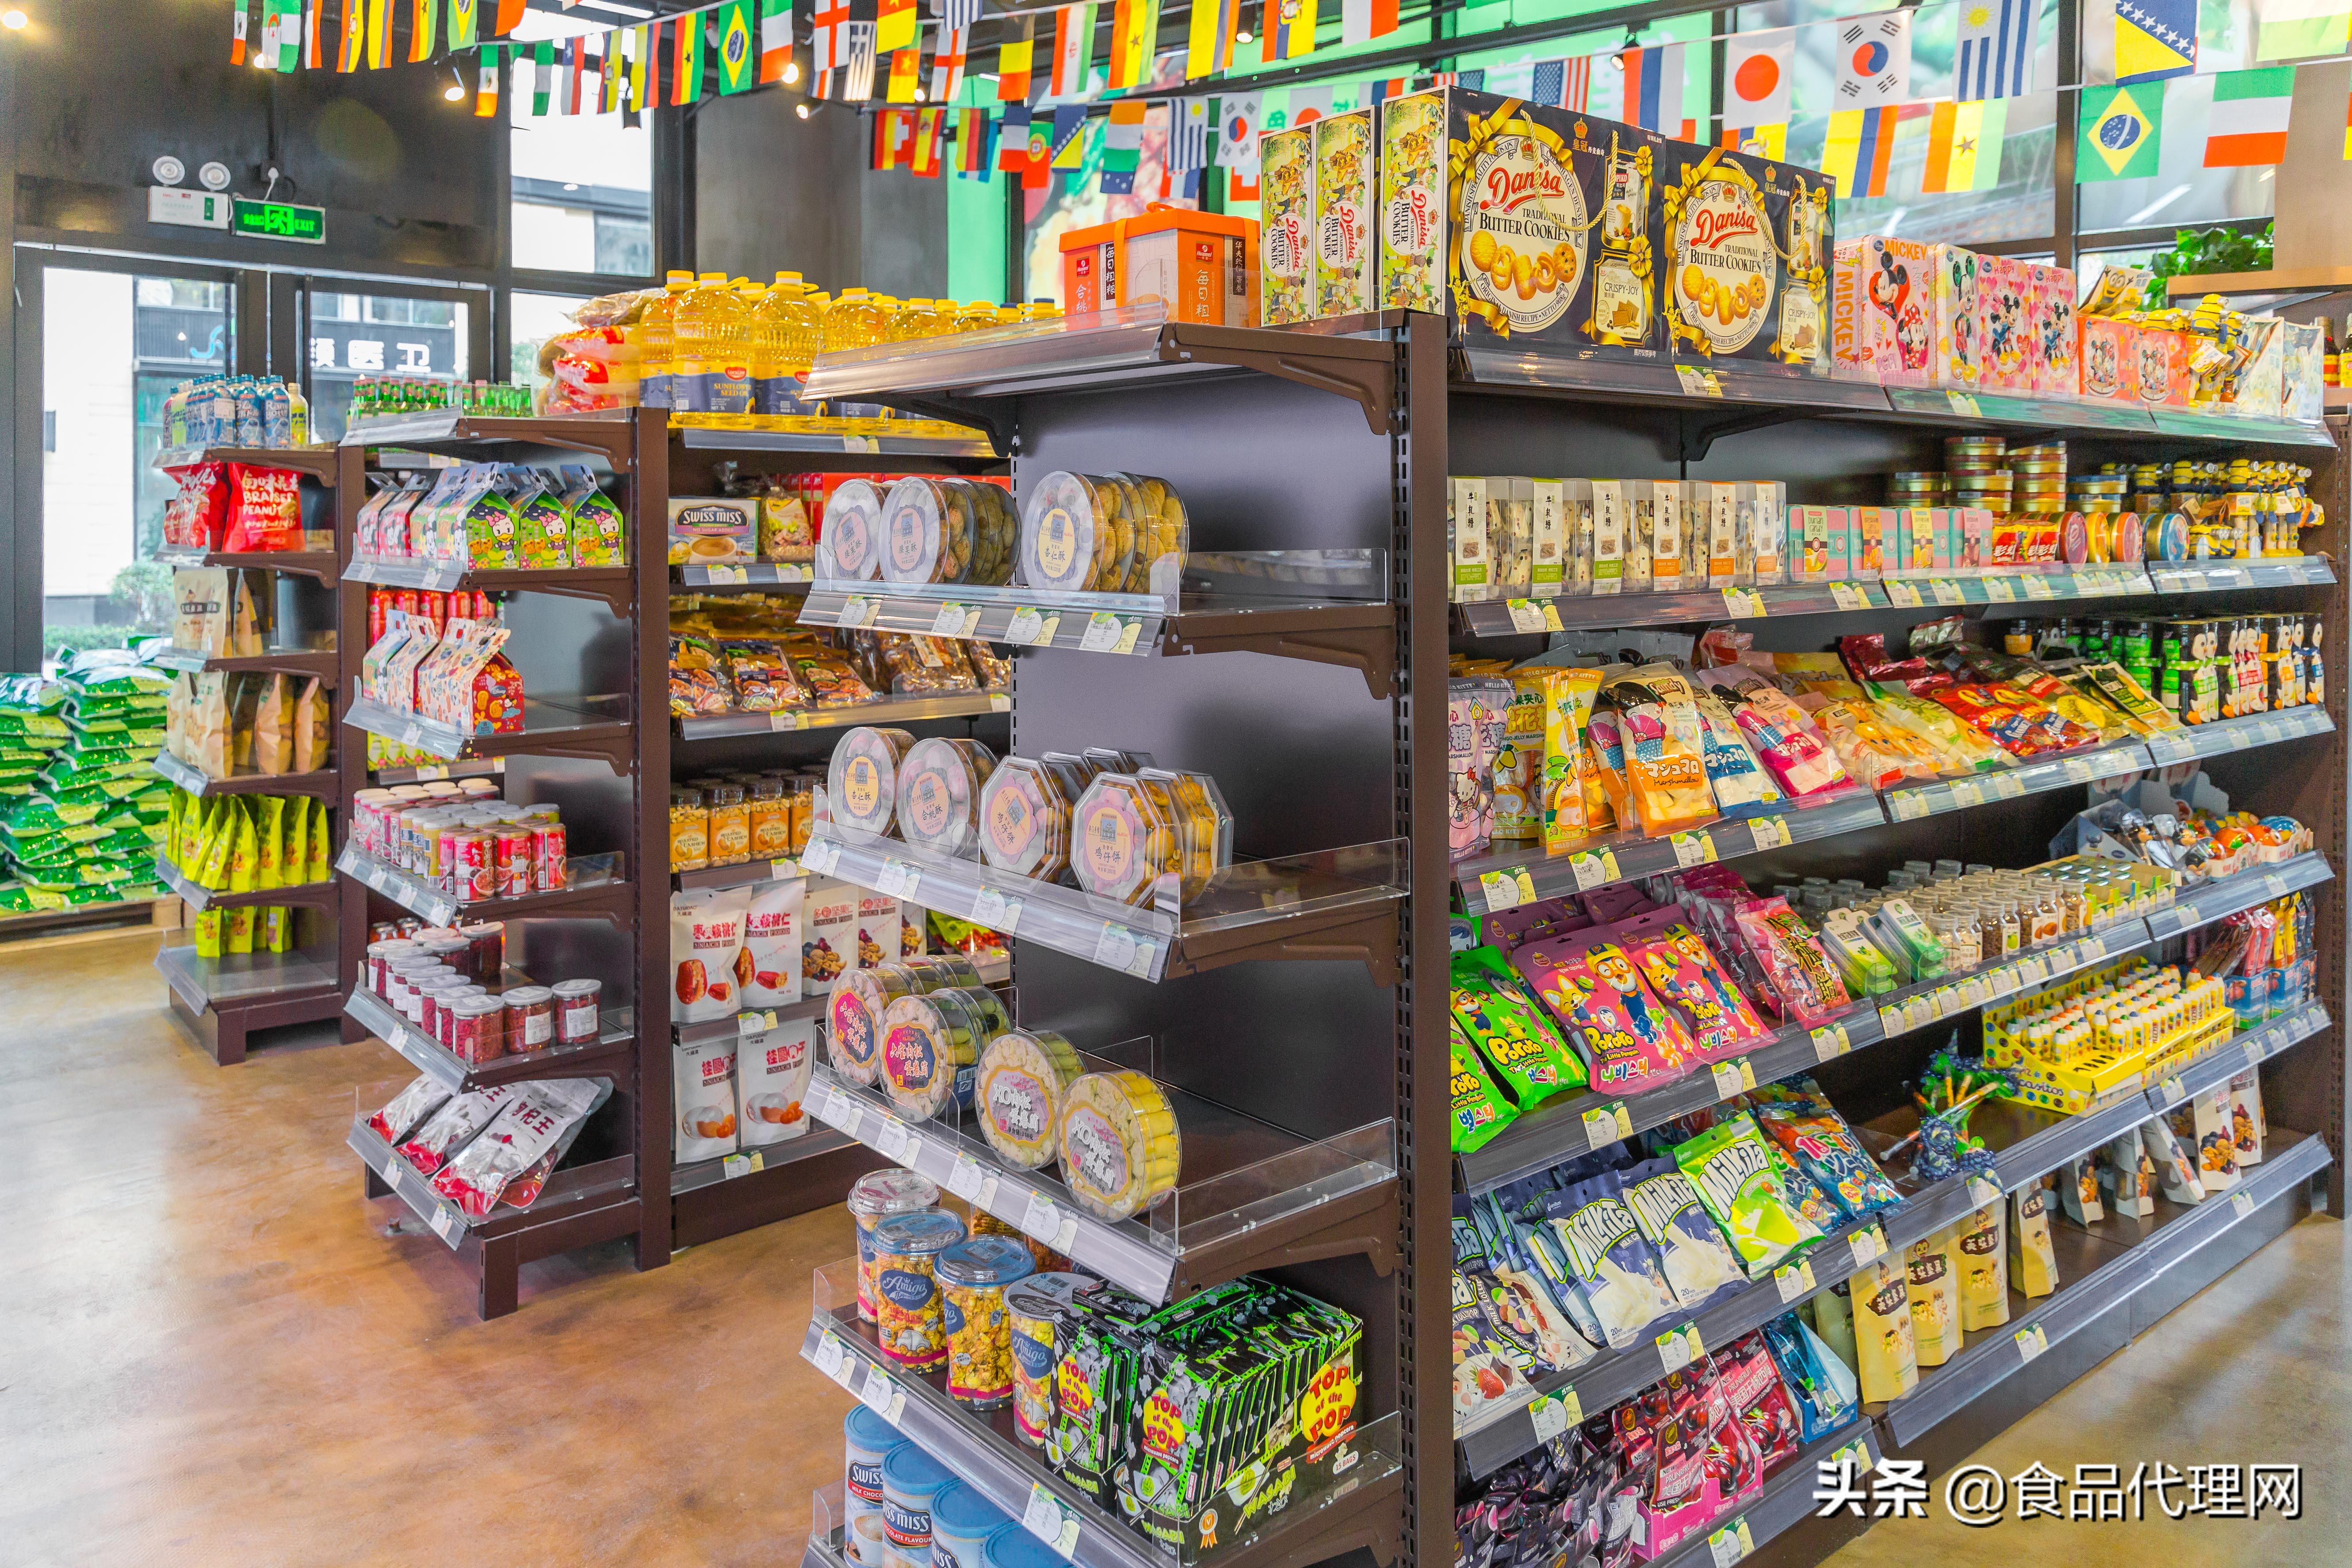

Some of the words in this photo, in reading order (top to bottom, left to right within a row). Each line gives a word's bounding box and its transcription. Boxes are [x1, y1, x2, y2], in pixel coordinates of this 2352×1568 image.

[1572, 140, 1587, 152] 皇冠
[1480, 162, 1565, 215] Danisa
[294, 218, 314, 231] EXIT
[1401, 202, 1410, 243] BUTTER
[1411, 190, 1426, 250] Danisa
[1480, 212, 1522, 236] BUTTER
[1524, 220, 1569, 242] COOKIES
[1690, 204, 1758, 250] Danisa
[1340, 205, 1355, 262] Danisa
[1286, 217, 1300, 271] Danisa
[1725, 245, 1759, 257] TRADITIONAL
[1884, 239, 1927, 260] MICKEY
[1690, 249, 1724, 266] BUTTER
[1726, 256, 1761, 274] COOKIES
[1994, 265, 2014, 275] Happy
[1196, 269, 1210, 324] 每日粗
[1604, 282, 1639, 296] CRISPY-JOY
[1541, 304, 1557, 318] NETTO
[1788, 308, 1816, 319] CRISPY-JOY
[1835, 271, 1853, 360] MICKEY
[683, 510, 714, 524] SWISS
[717, 511, 742, 524] MISS
[1044, 548, 1065, 561] 杏仁酥
[1705, 748, 1748, 767] マシュマロ
[1645, 758, 1699, 778] マシュマロ
[1654, 776, 1699, 787] Marshmallow
[852, 791, 871, 802] 杏仁酥
[921, 804, 943, 821] 合桃酥
[1095, 849, 1121, 864] 鸡仔饼
[1454, 850, 1465, 859] HELLO
[1584, 1026, 1635, 1056] Pororo
[1698, 1026, 1737, 1051] 나비스틱
[1487, 1036, 1543, 1066] Pororo
[904, 1060, 928, 1078] 蛋卷筒
[1601, 1056, 1649, 1083] 나비스틱
[1467, 1093, 1485, 1104] Penguin
[1010, 1107, 1039, 1132] 蛋卷筒
[1457, 1102, 1495, 1133] 별스틱
[883, 1276, 928, 1296] Amigo
[1610, 1327, 1618, 1336] 20
[1013, 1336, 1048, 1365] Amigo
[1063, 1359, 1088, 1384] TOP
[1074, 1382, 1083, 1395] the
[1308, 1365, 1349, 1399] TOP
[1062, 1387, 1088, 1411] POP
[1151, 1394, 1182, 1418] TOP
[1316, 1400, 1325, 1414] of
[1328, 1392, 1342, 1404] the
[1076, 1414, 1090, 1425] popcorn
[1162, 1418, 1173, 1431] the
[1309, 1405, 1350, 1443] POP
[1147, 1425, 1178, 1450] POP
[1335, 1425, 1354, 1439] popcorn
[1143, 1445, 1163, 1458] microwave
[1163, 1453, 1179, 1465] popcorn
[1342, 1455, 1356, 1467] BAGS
[1633, 1452, 1646, 1461] NEW
[1663, 1466, 1675, 1476] NEW
[852, 1485, 862, 1494] MILK
[1243, 1465, 1296, 1518] WASABI
[897, 1513, 930, 1532] MISS
